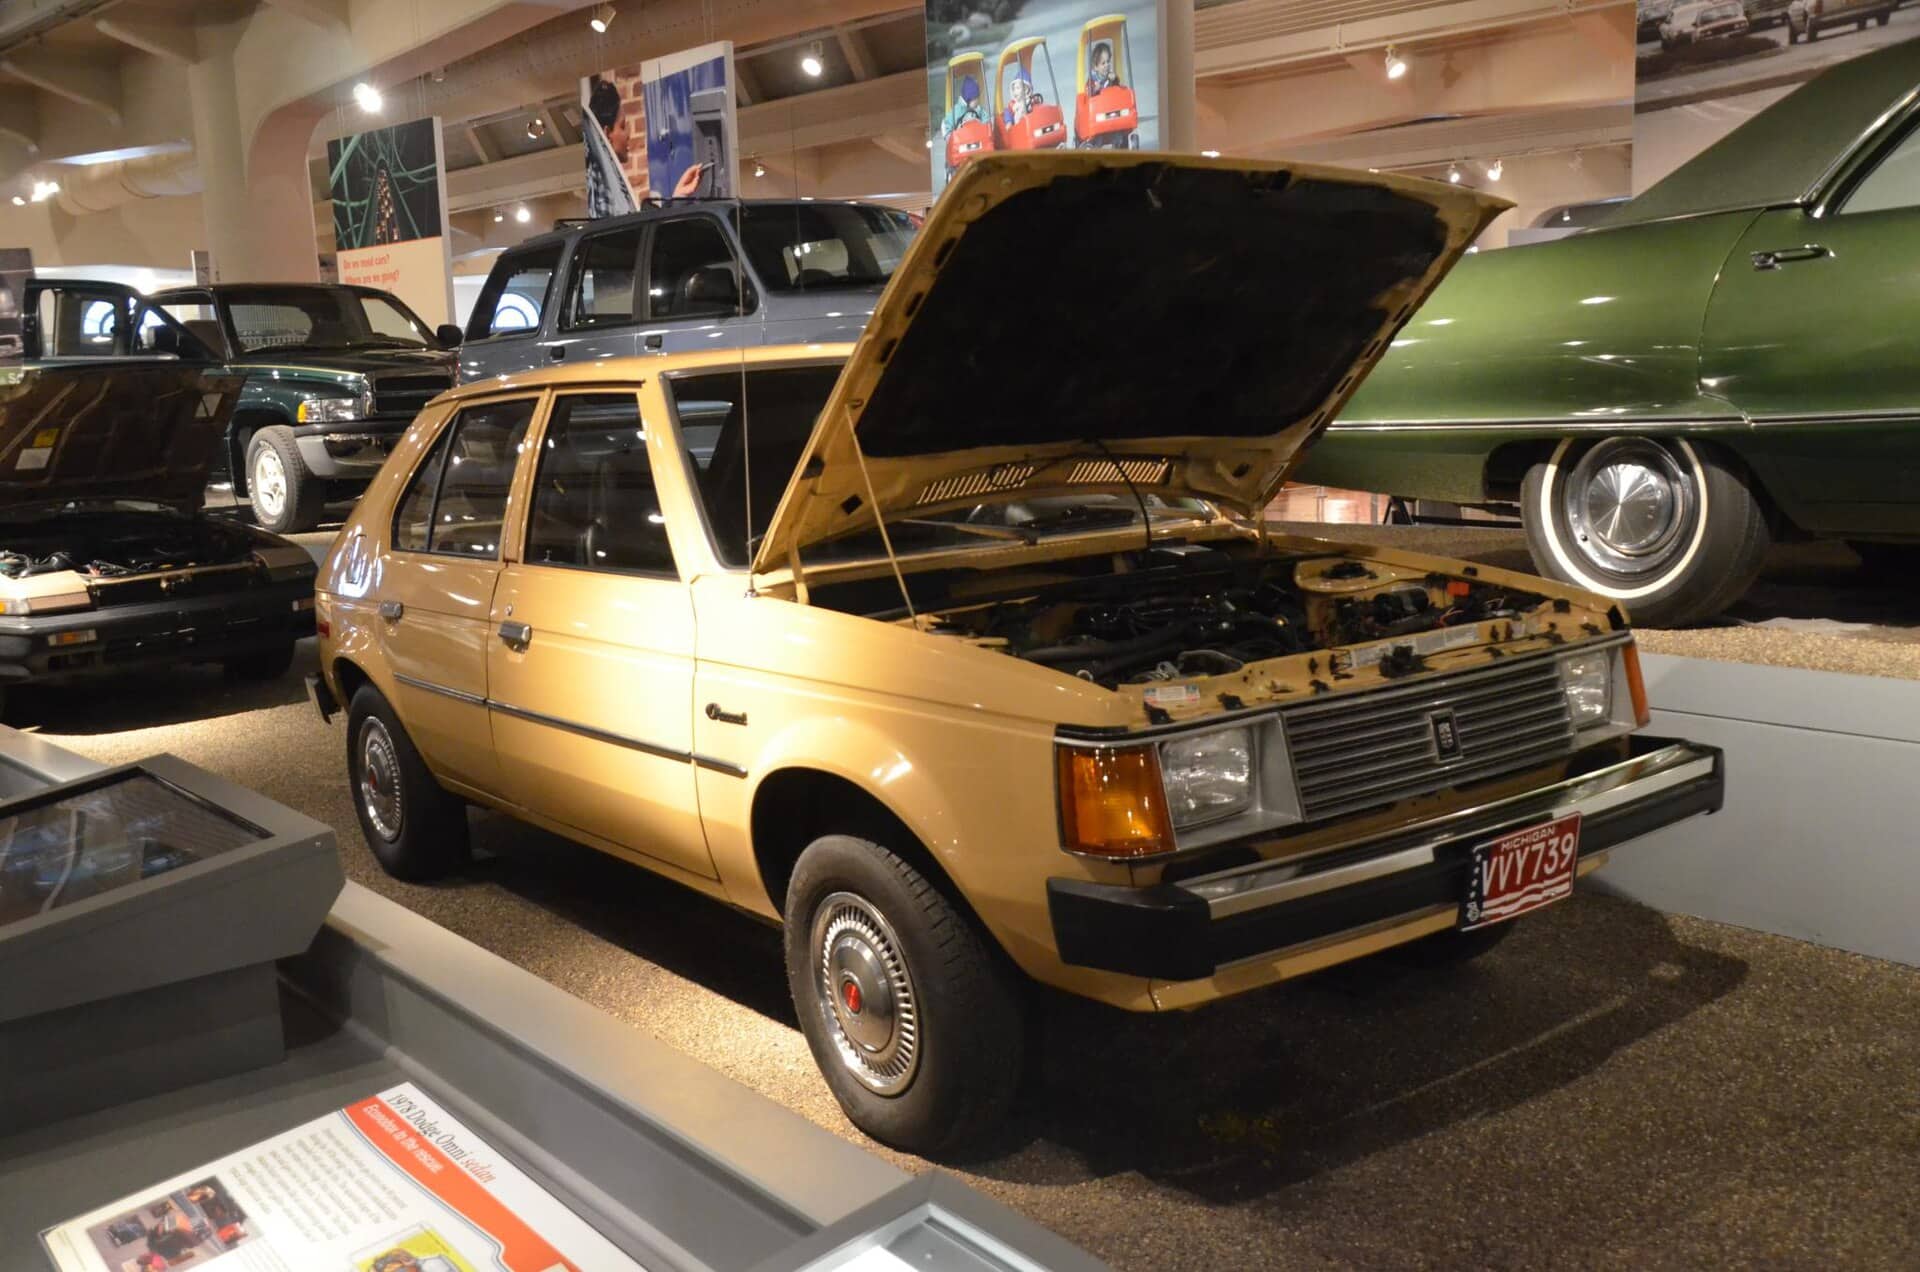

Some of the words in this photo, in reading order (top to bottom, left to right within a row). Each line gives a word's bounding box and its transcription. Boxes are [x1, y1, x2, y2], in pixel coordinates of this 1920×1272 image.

[1482, 832, 1575, 897] VVY739
[1501, 826, 1556, 852] MICHIGAN
[387, 1093, 416, 1114] 1978
[407, 1109, 441, 1138] Dodge
[435, 1132, 472, 1162] Omni
[463, 1157, 497, 1183] sedan
